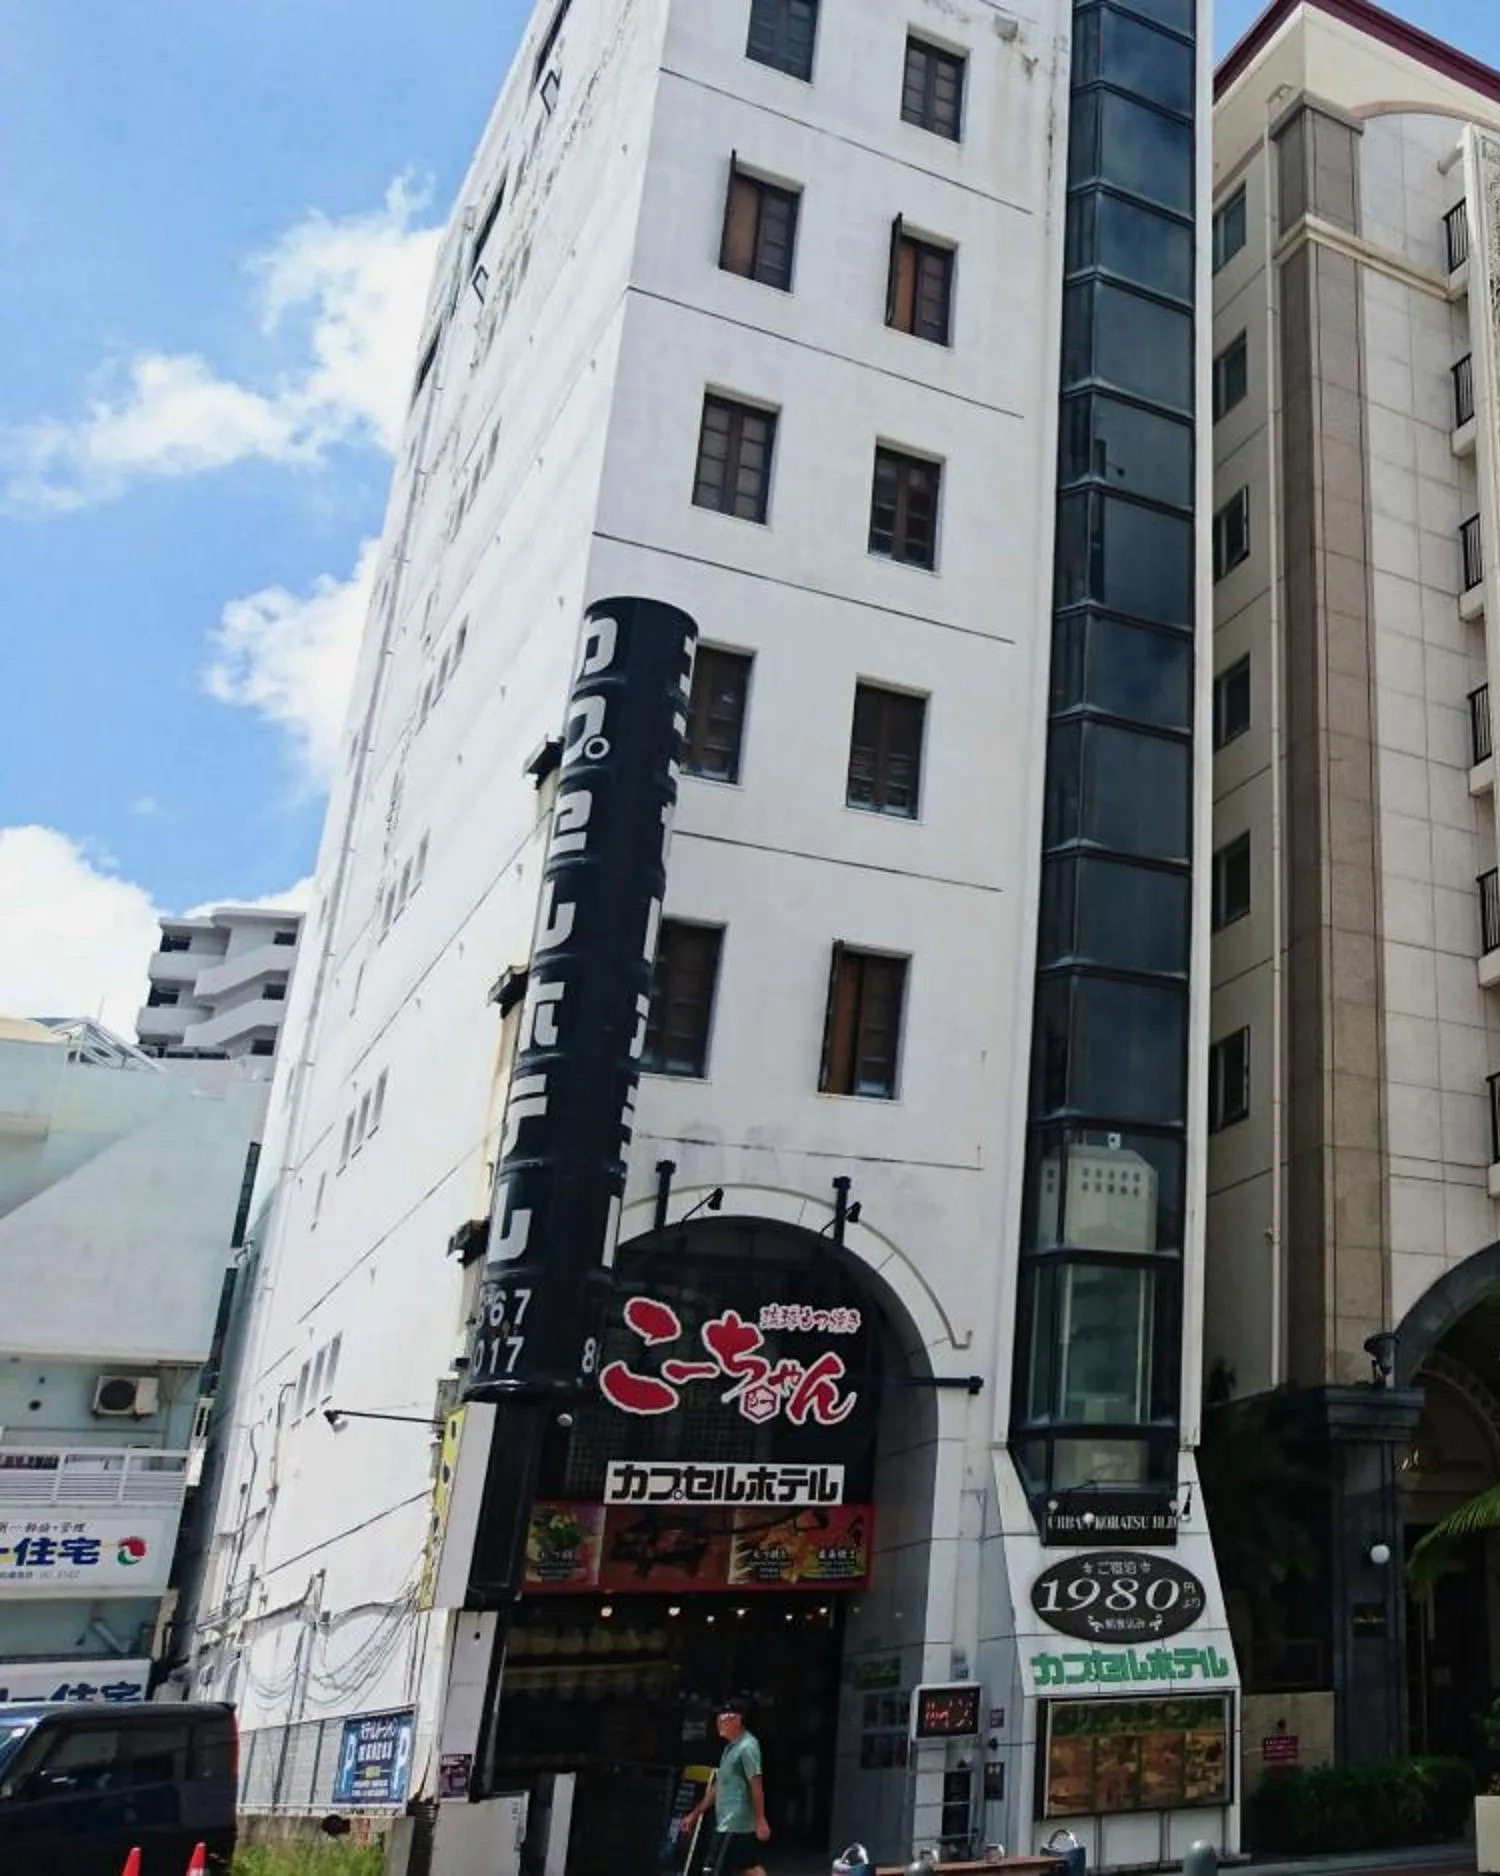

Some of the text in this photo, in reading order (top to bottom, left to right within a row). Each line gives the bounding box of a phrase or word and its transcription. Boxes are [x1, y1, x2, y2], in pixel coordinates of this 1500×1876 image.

[476, 1288, 532, 1330] 67
[610, 1464, 838, 1501] カプセルホテル
[1038, 1577, 1180, 1612] 1980
[1029, 1646, 1230, 1686] カプセルホテル
